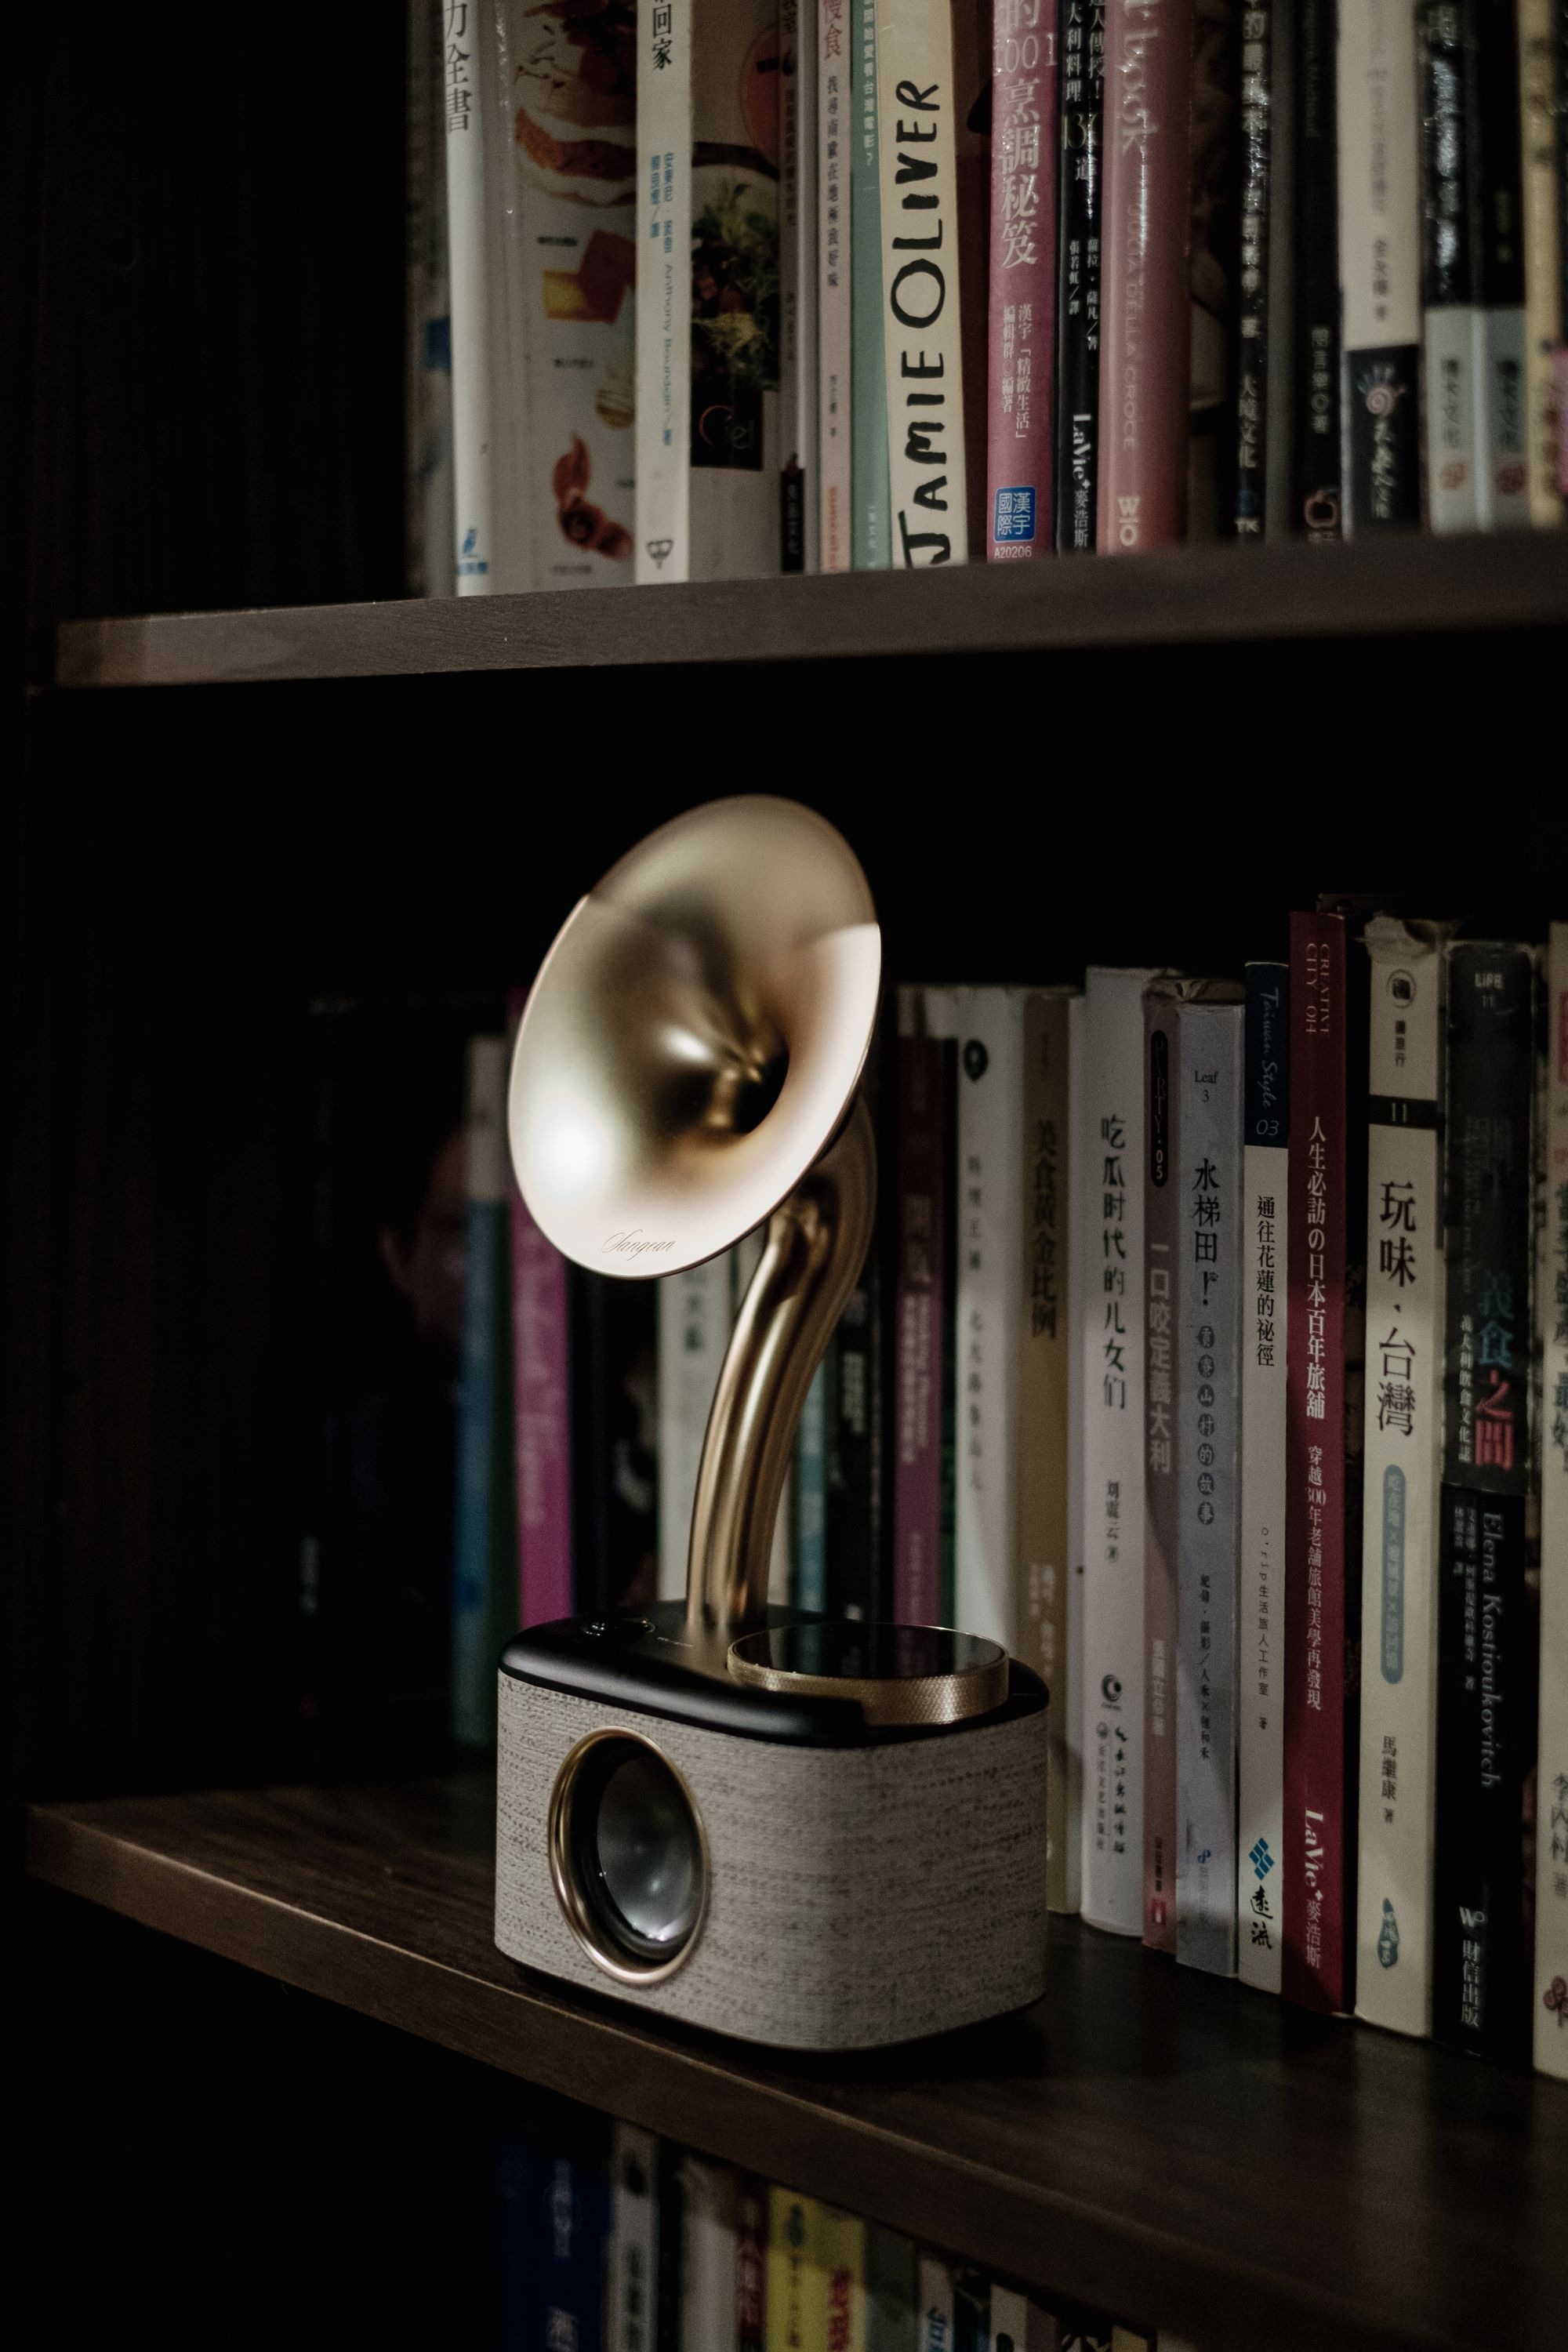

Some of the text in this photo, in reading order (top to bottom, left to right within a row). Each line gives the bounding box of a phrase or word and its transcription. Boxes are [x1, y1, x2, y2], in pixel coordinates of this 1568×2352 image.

[651, 0, 673, 70] 回家
[890, 80, 951, 569] JAMIE OLIVER
[1071, 414, 1092, 482] LaVie
[993, 546, 1033, 560] A20206
[1256, 1119, 1279, 1136] 03
[1102, 1113, 1126, 1410] 吃瓜时代的儿女们
[1257, 1195, 1276, 1368] 通往花蓮的祕徑
[1304, 1806, 1324, 1888] LaVie
